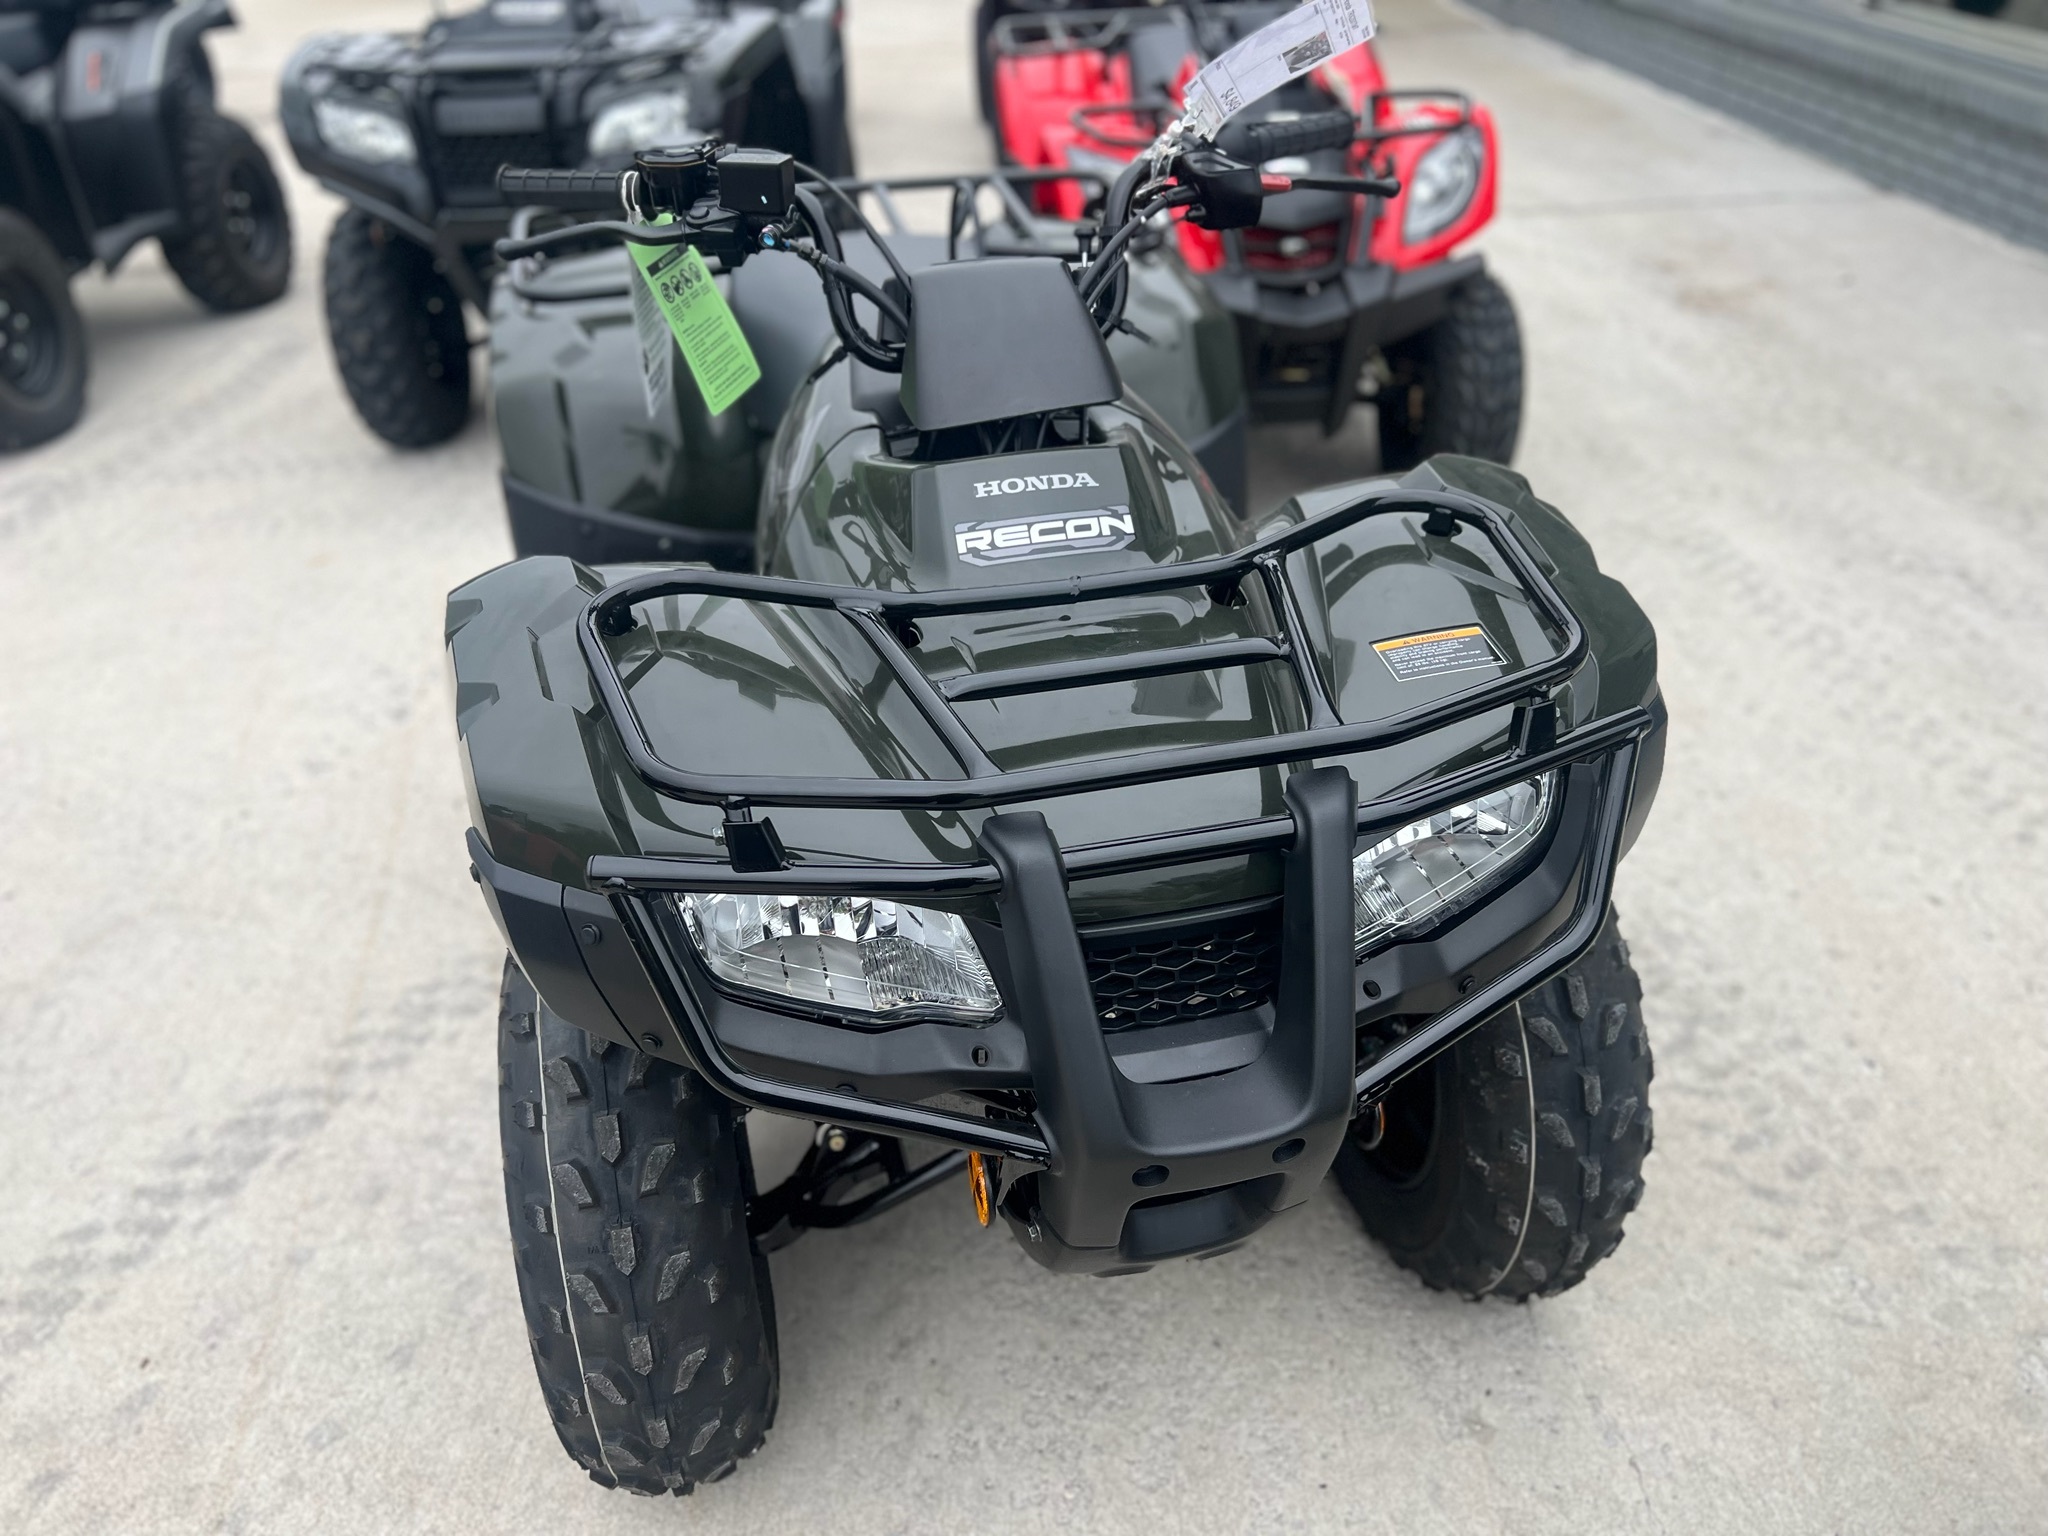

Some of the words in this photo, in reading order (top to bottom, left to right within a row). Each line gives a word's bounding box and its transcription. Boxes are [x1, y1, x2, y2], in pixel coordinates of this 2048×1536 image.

[973, 472, 1100, 498] HONDA
[954, 514, 1136, 555] RECON
[1411, 632, 1455, 643] WARNING
